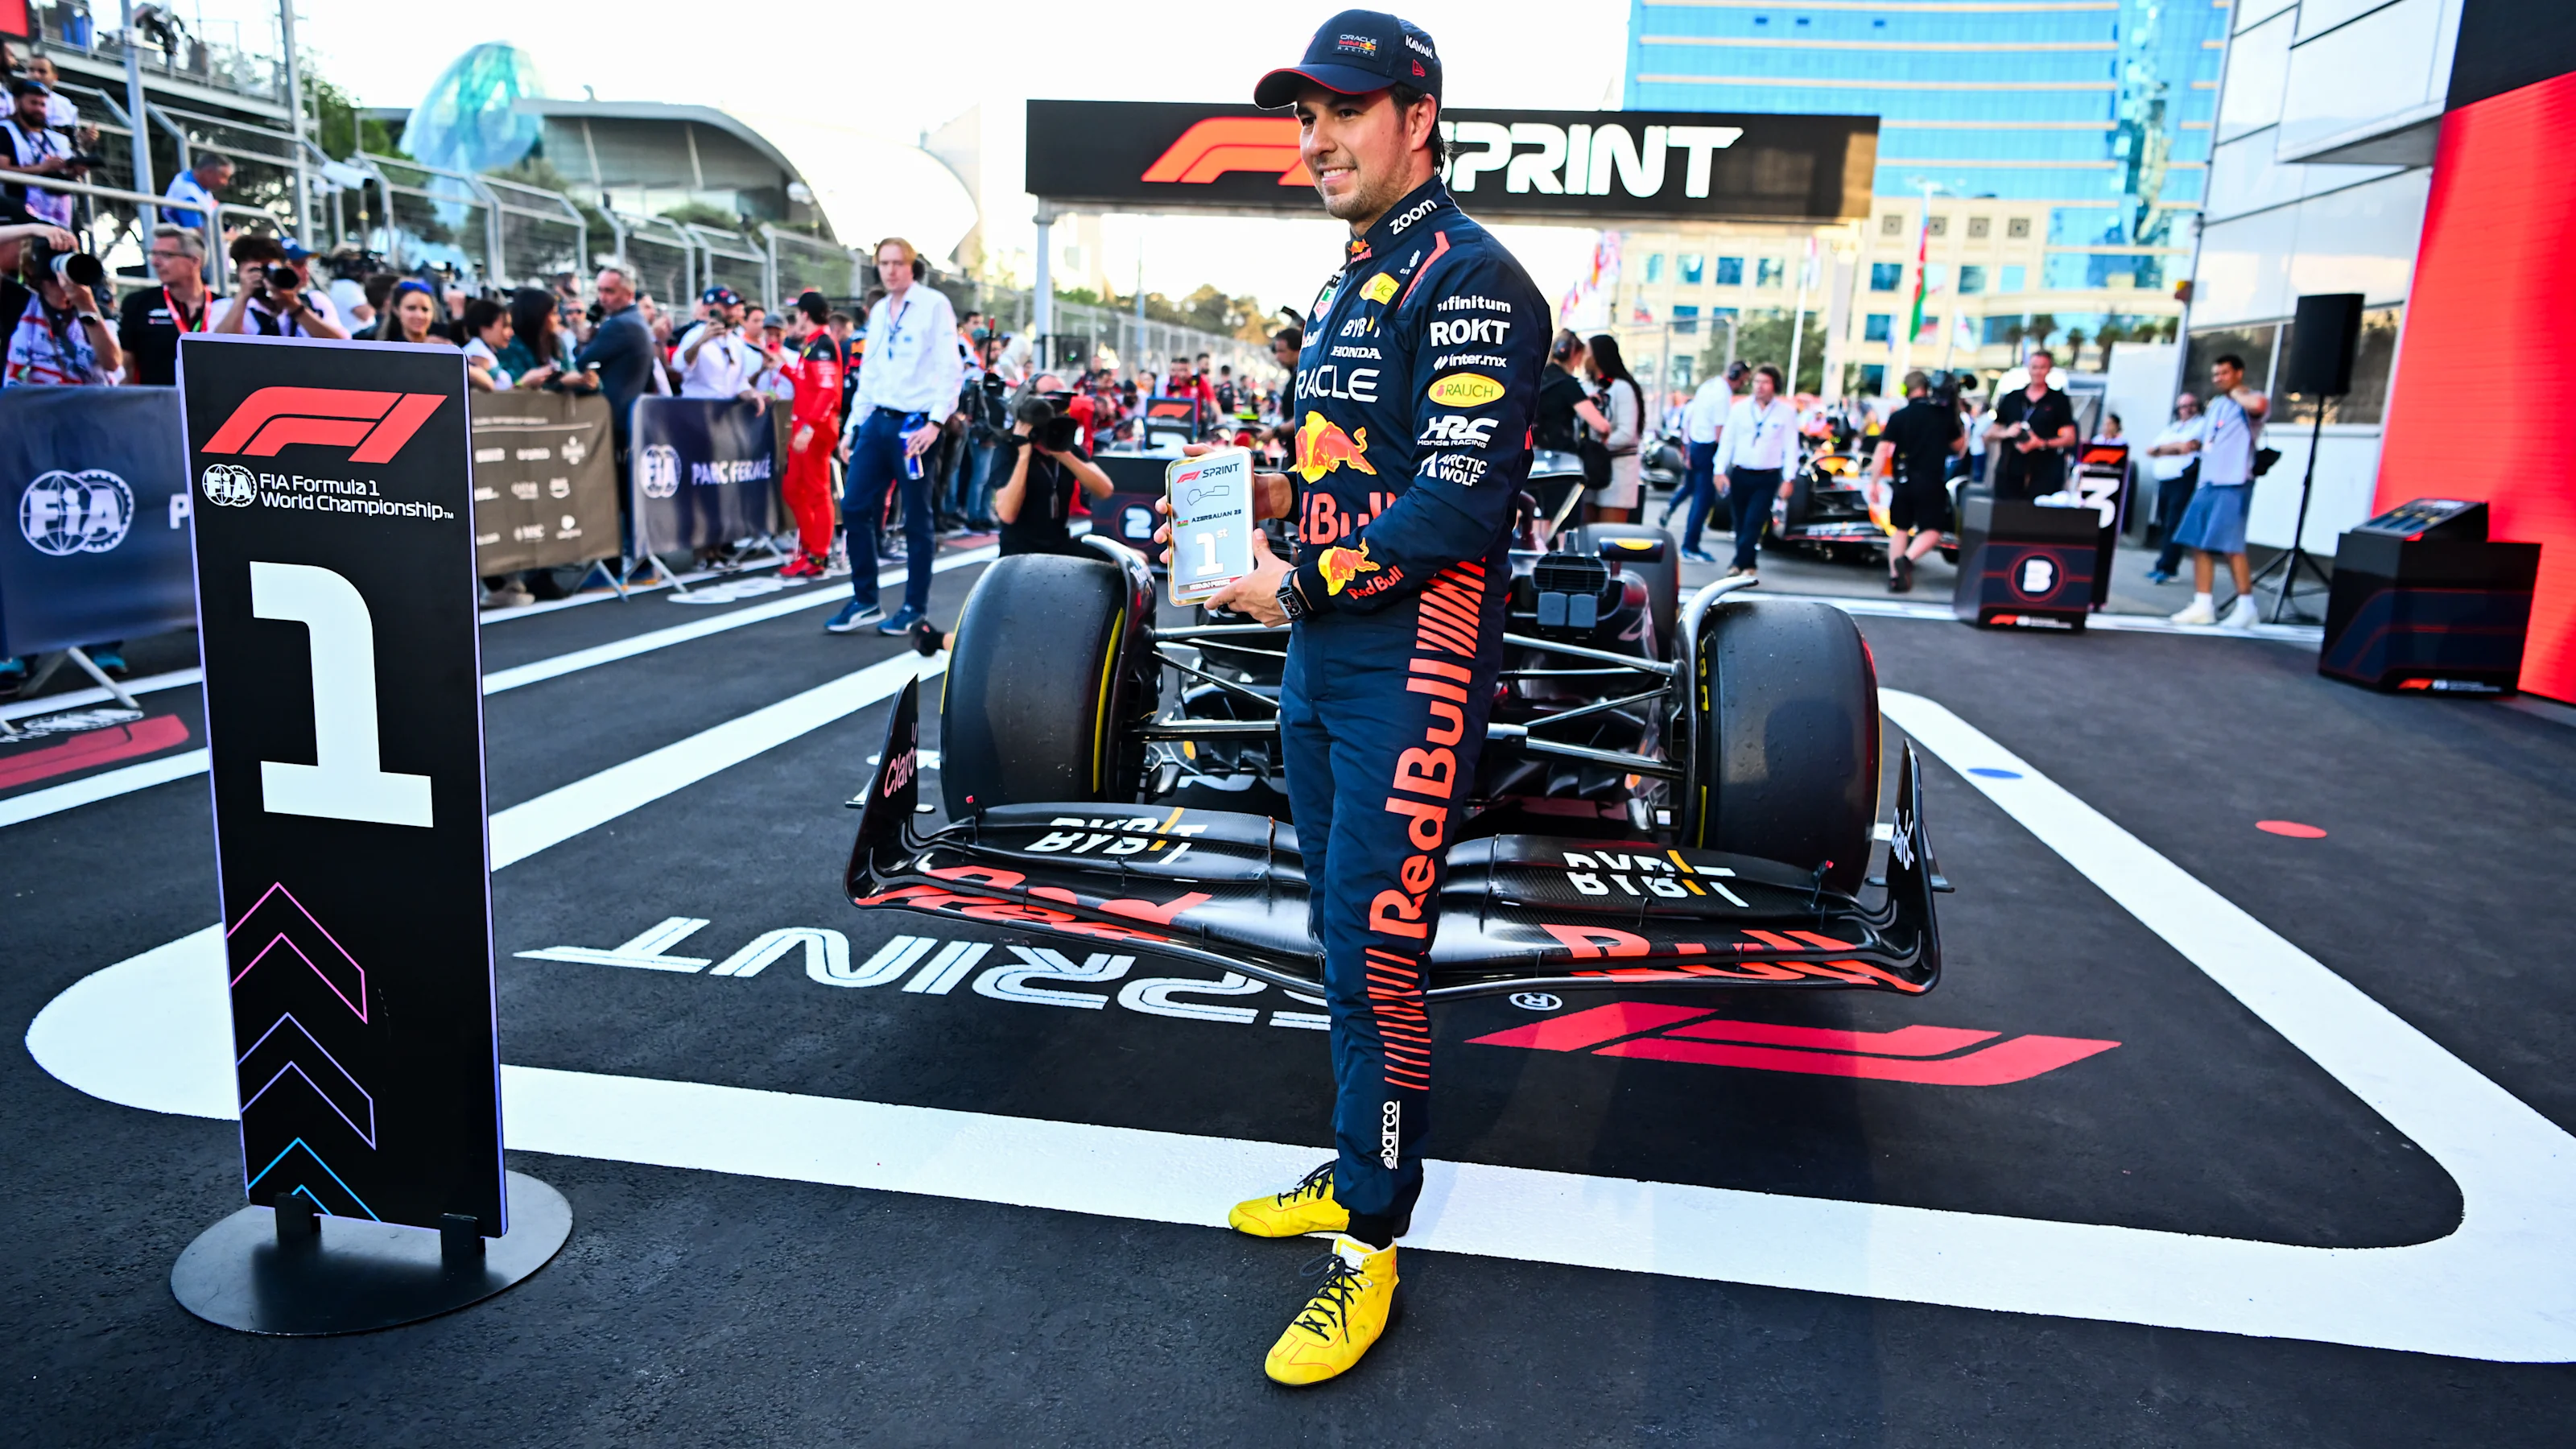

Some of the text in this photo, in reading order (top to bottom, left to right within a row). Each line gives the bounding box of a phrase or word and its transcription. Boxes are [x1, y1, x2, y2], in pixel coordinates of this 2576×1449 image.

[1340, 34, 1377, 44] ORACLE
[1405, 35, 1433, 59] KAVAK
[1336, 46, 1375, 57] RACING
[1389, 199, 1438, 236] zoom
[1430, 318, 1511, 347] ROKT
[1330, 345, 1382, 360] HONDA
[1294, 365, 1380, 402] RACLE
[1445, 383, 1493, 398] RAUCH
[1419, 415, 1499, 443] HRC
[1451, 439, 1488, 449] RACING
[691, 460, 729, 485] PARC
[1202, 463, 1241, 479] SPRINT
[1437, 454, 1488, 475] ARCTIC
[1439, 465, 1480, 486] WOLF
[260, 473, 290, 490] FIA
[292, 476, 366, 496] Formula
[369, 481, 381, 497] 1
[261, 492, 314, 510] World
[1125, 507, 1152, 539] 2
[250, 561, 433, 828] 1
[884, 747, 917, 798] Claro
[1381, 1100, 1400, 1170] sparco
